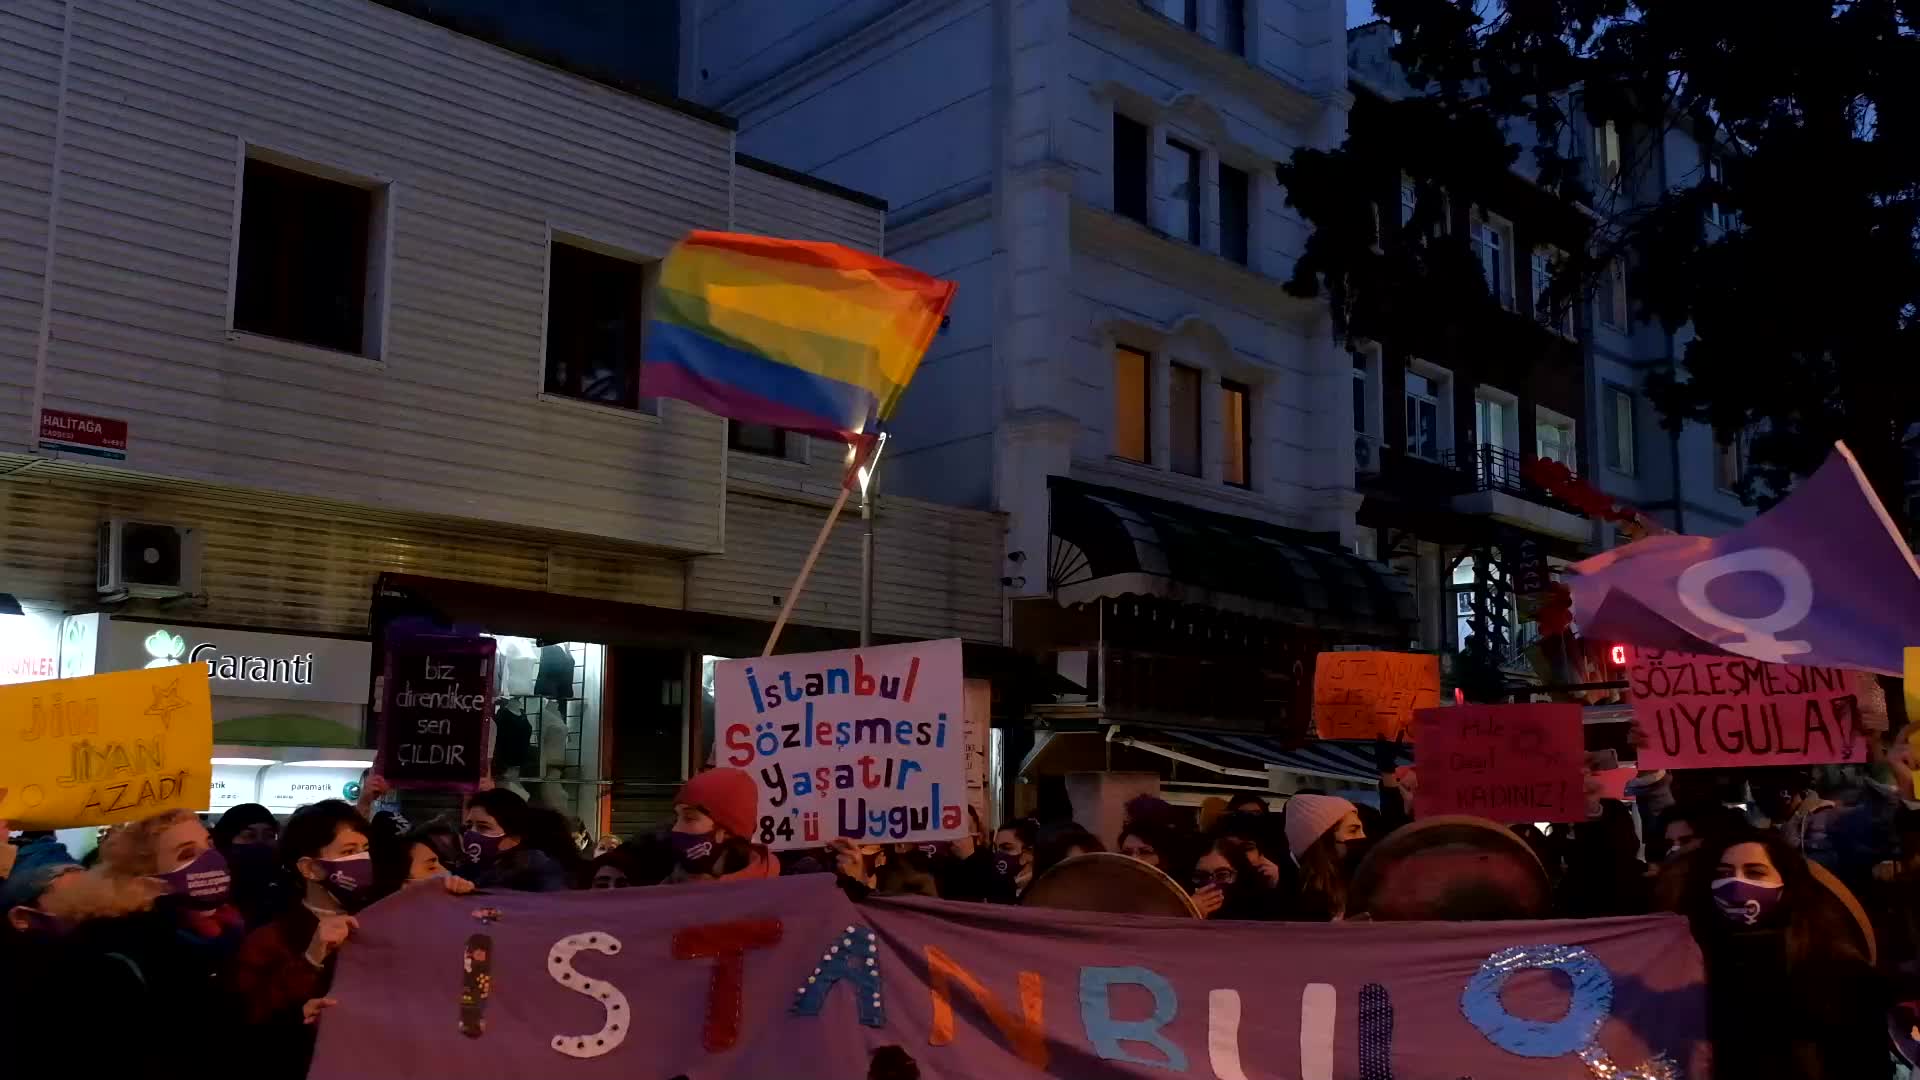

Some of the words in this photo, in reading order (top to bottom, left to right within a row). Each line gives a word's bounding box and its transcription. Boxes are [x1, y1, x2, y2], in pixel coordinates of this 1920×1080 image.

[188, 642, 313, 685] Garanti
[424, 655, 456, 680] biz
[745, 654, 920, 713] İstanbul
[396, 679, 485, 712] direndikçe
[416, 719, 450, 735] sen
[725, 702, 947, 767] Sözleşmesi
[397, 743, 466, 767] ÇILDIR
[760, 755, 922, 807] yaşatır
[838, 783, 962, 839] Uygula
